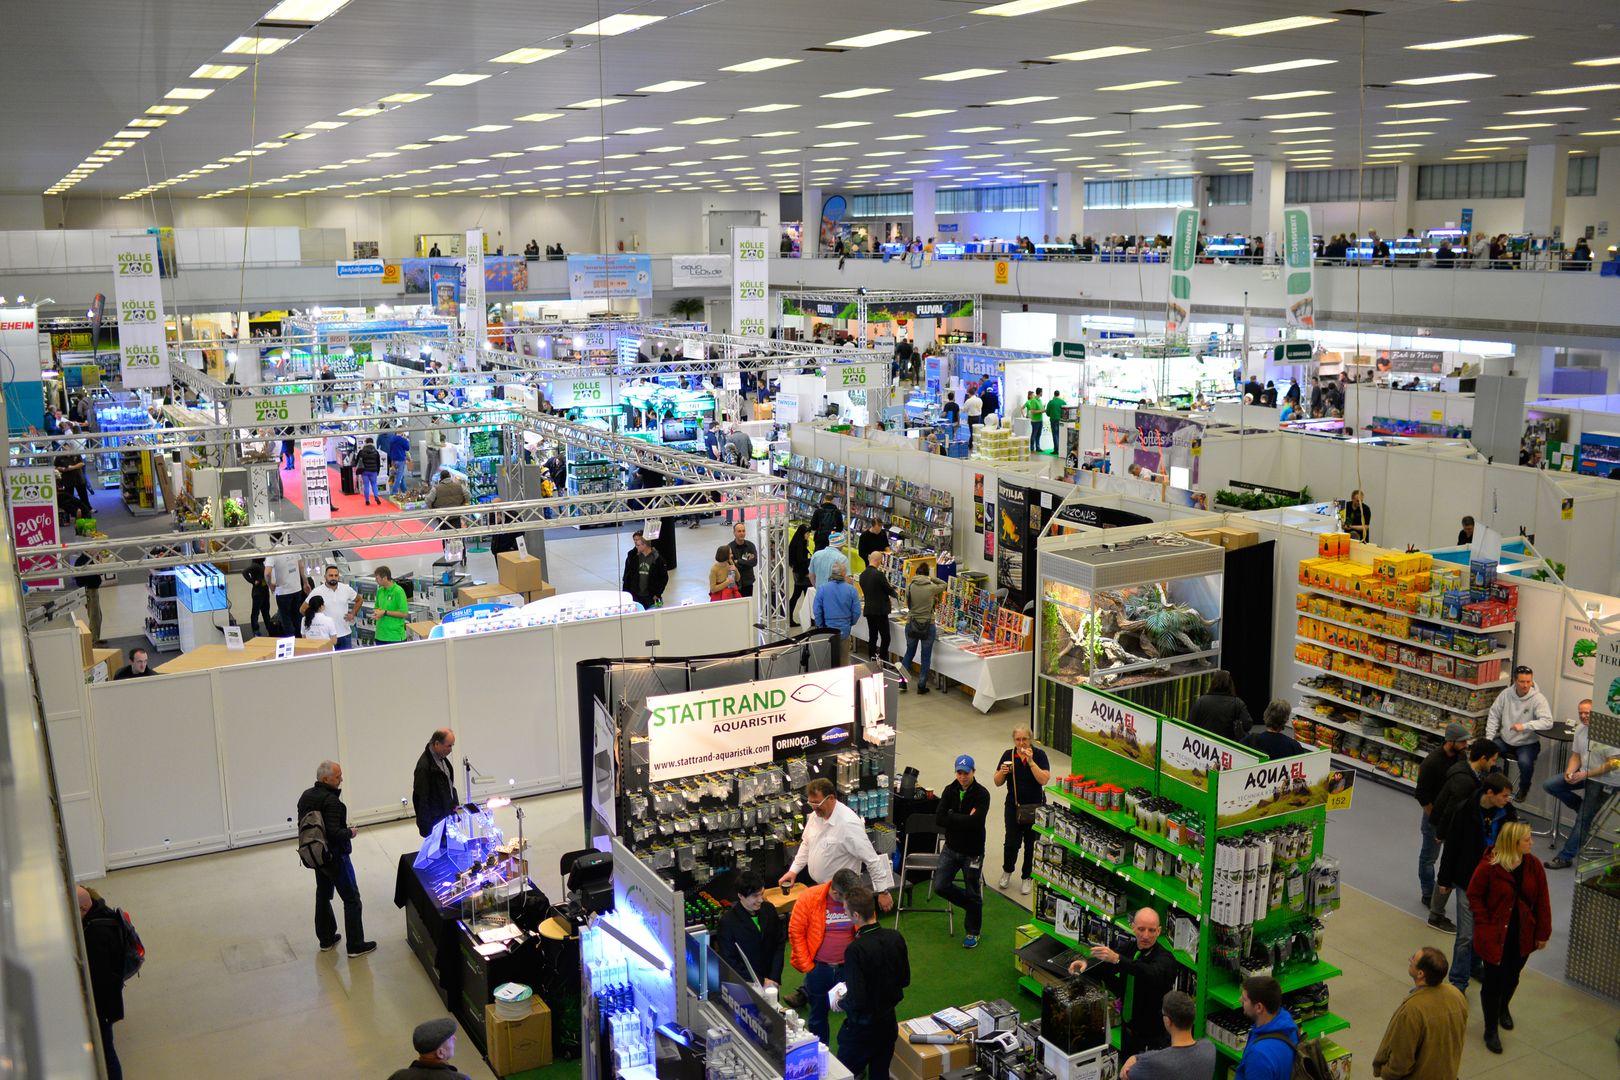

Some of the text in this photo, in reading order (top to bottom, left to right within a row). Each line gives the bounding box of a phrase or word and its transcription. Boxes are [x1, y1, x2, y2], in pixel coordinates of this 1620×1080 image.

[739, 240, 765, 249] KÖLLE
[118, 251, 152, 262] KÖLLE
[739, 280, 765, 289] KÖLLE
[122, 299, 155, 310] KÖLLE
[916, 304, 944, 315] FLUVAL
[0, 321, 34, 331] EHEIM
[740, 318, 765, 326] KÖLLE
[125, 344, 159, 355] KÖLLE
[842, 366, 866, 375] KÖLLE
[572, 381, 600, 389] KÖLLE
[255, 399, 288, 409] KÖLLE
[9, 472, 52, 486] KÖLLE
[16, 512, 52, 536] 20%
[27, 529, 44, 546] auf
[652, 688, 787, 728] STATTRAND
[713, 713, 787, 734] AQUARISTIK
[776, 735, 810, 750] ORINOCO
[653, 743, 770, 771] www.stattrand-aquaristik.com
[1331, 796, 1346, 806] 152
[721, 983, 769, 1044] Seachem
